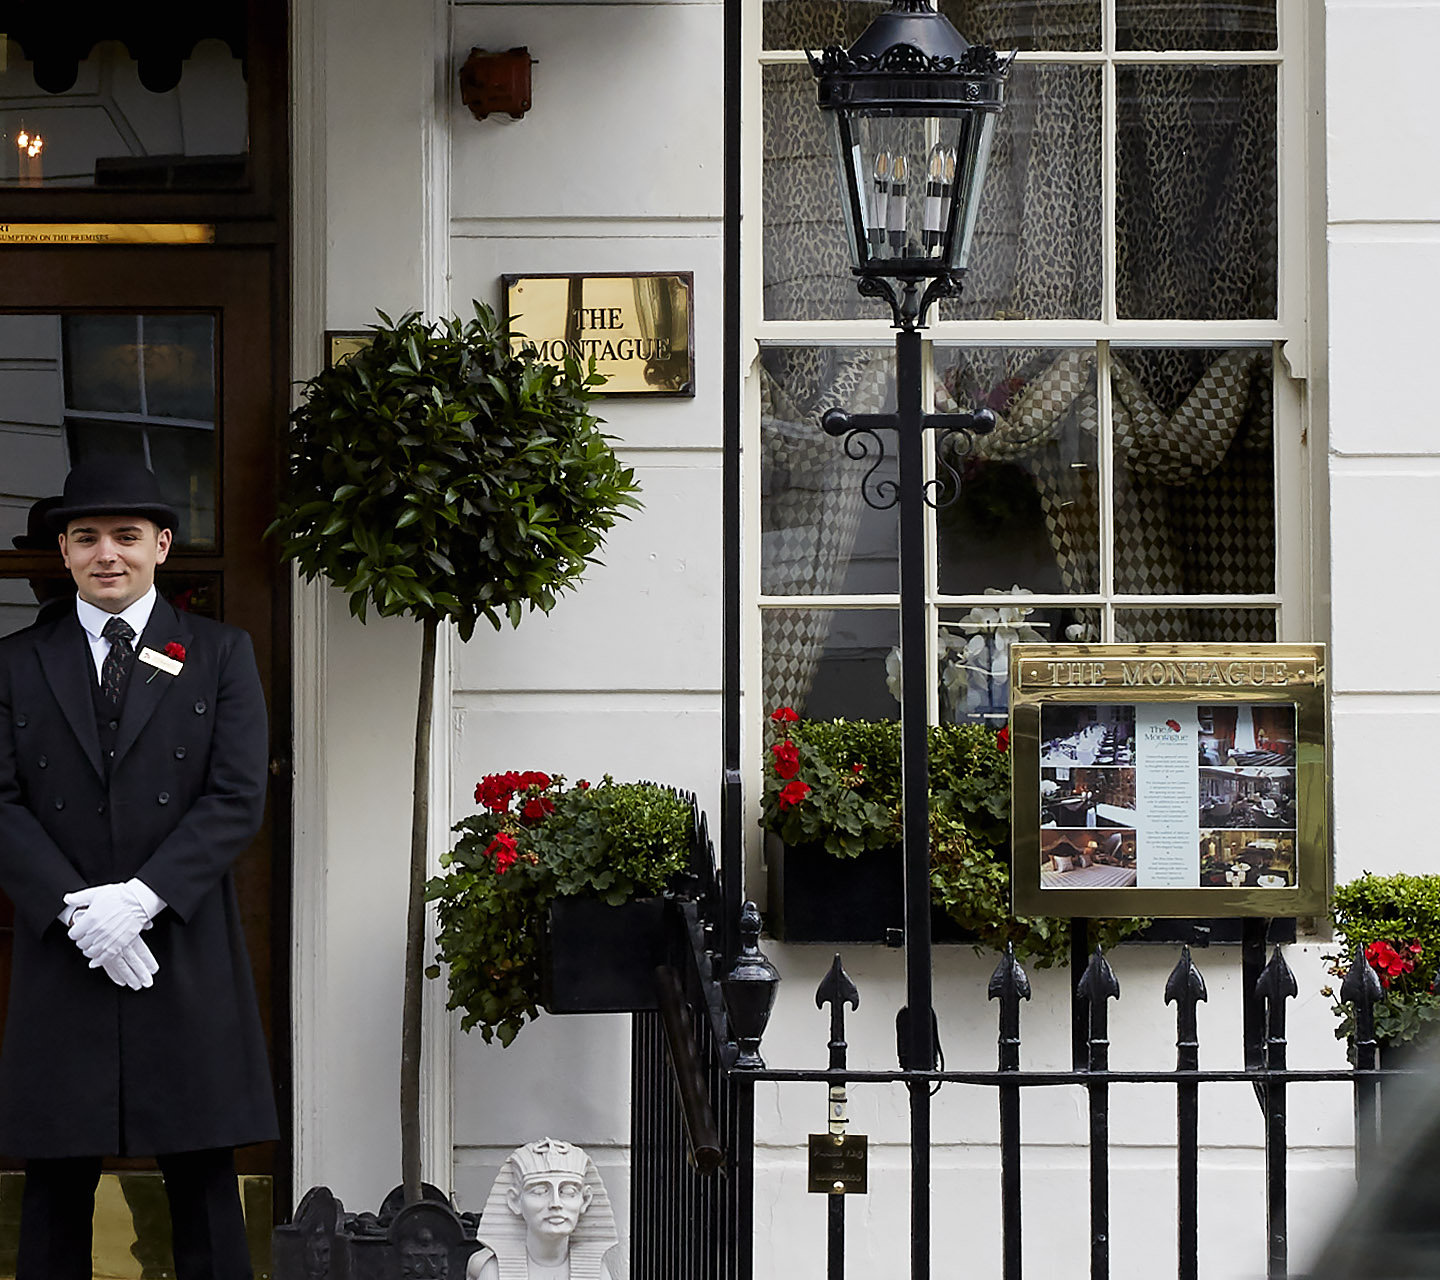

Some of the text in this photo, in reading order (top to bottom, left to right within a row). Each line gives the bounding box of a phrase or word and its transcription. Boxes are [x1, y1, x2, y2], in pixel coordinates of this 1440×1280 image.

[572, 308, 624, 330] THE
[528, 338, 672, 362] MONTAGUE
[1047, 662, 1289, 687] THE MONTAGUE
